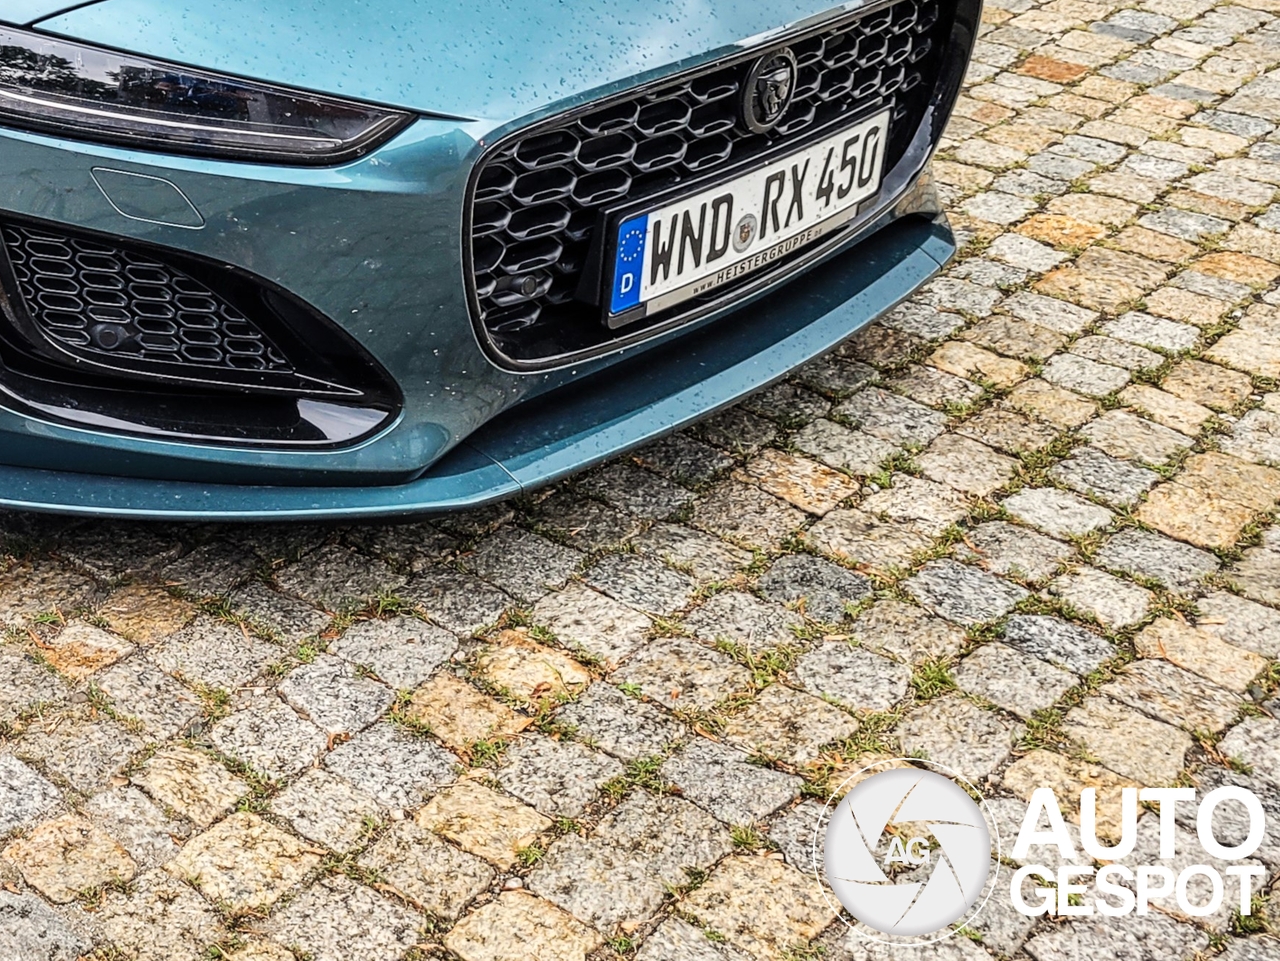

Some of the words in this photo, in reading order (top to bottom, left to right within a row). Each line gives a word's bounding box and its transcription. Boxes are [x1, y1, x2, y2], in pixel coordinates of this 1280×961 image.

[650, 192, 734, 286] WND
[759, 157, 811, 240] RX
[815, 125, 880, 209] 450
[620, 272, 634, 293] D
